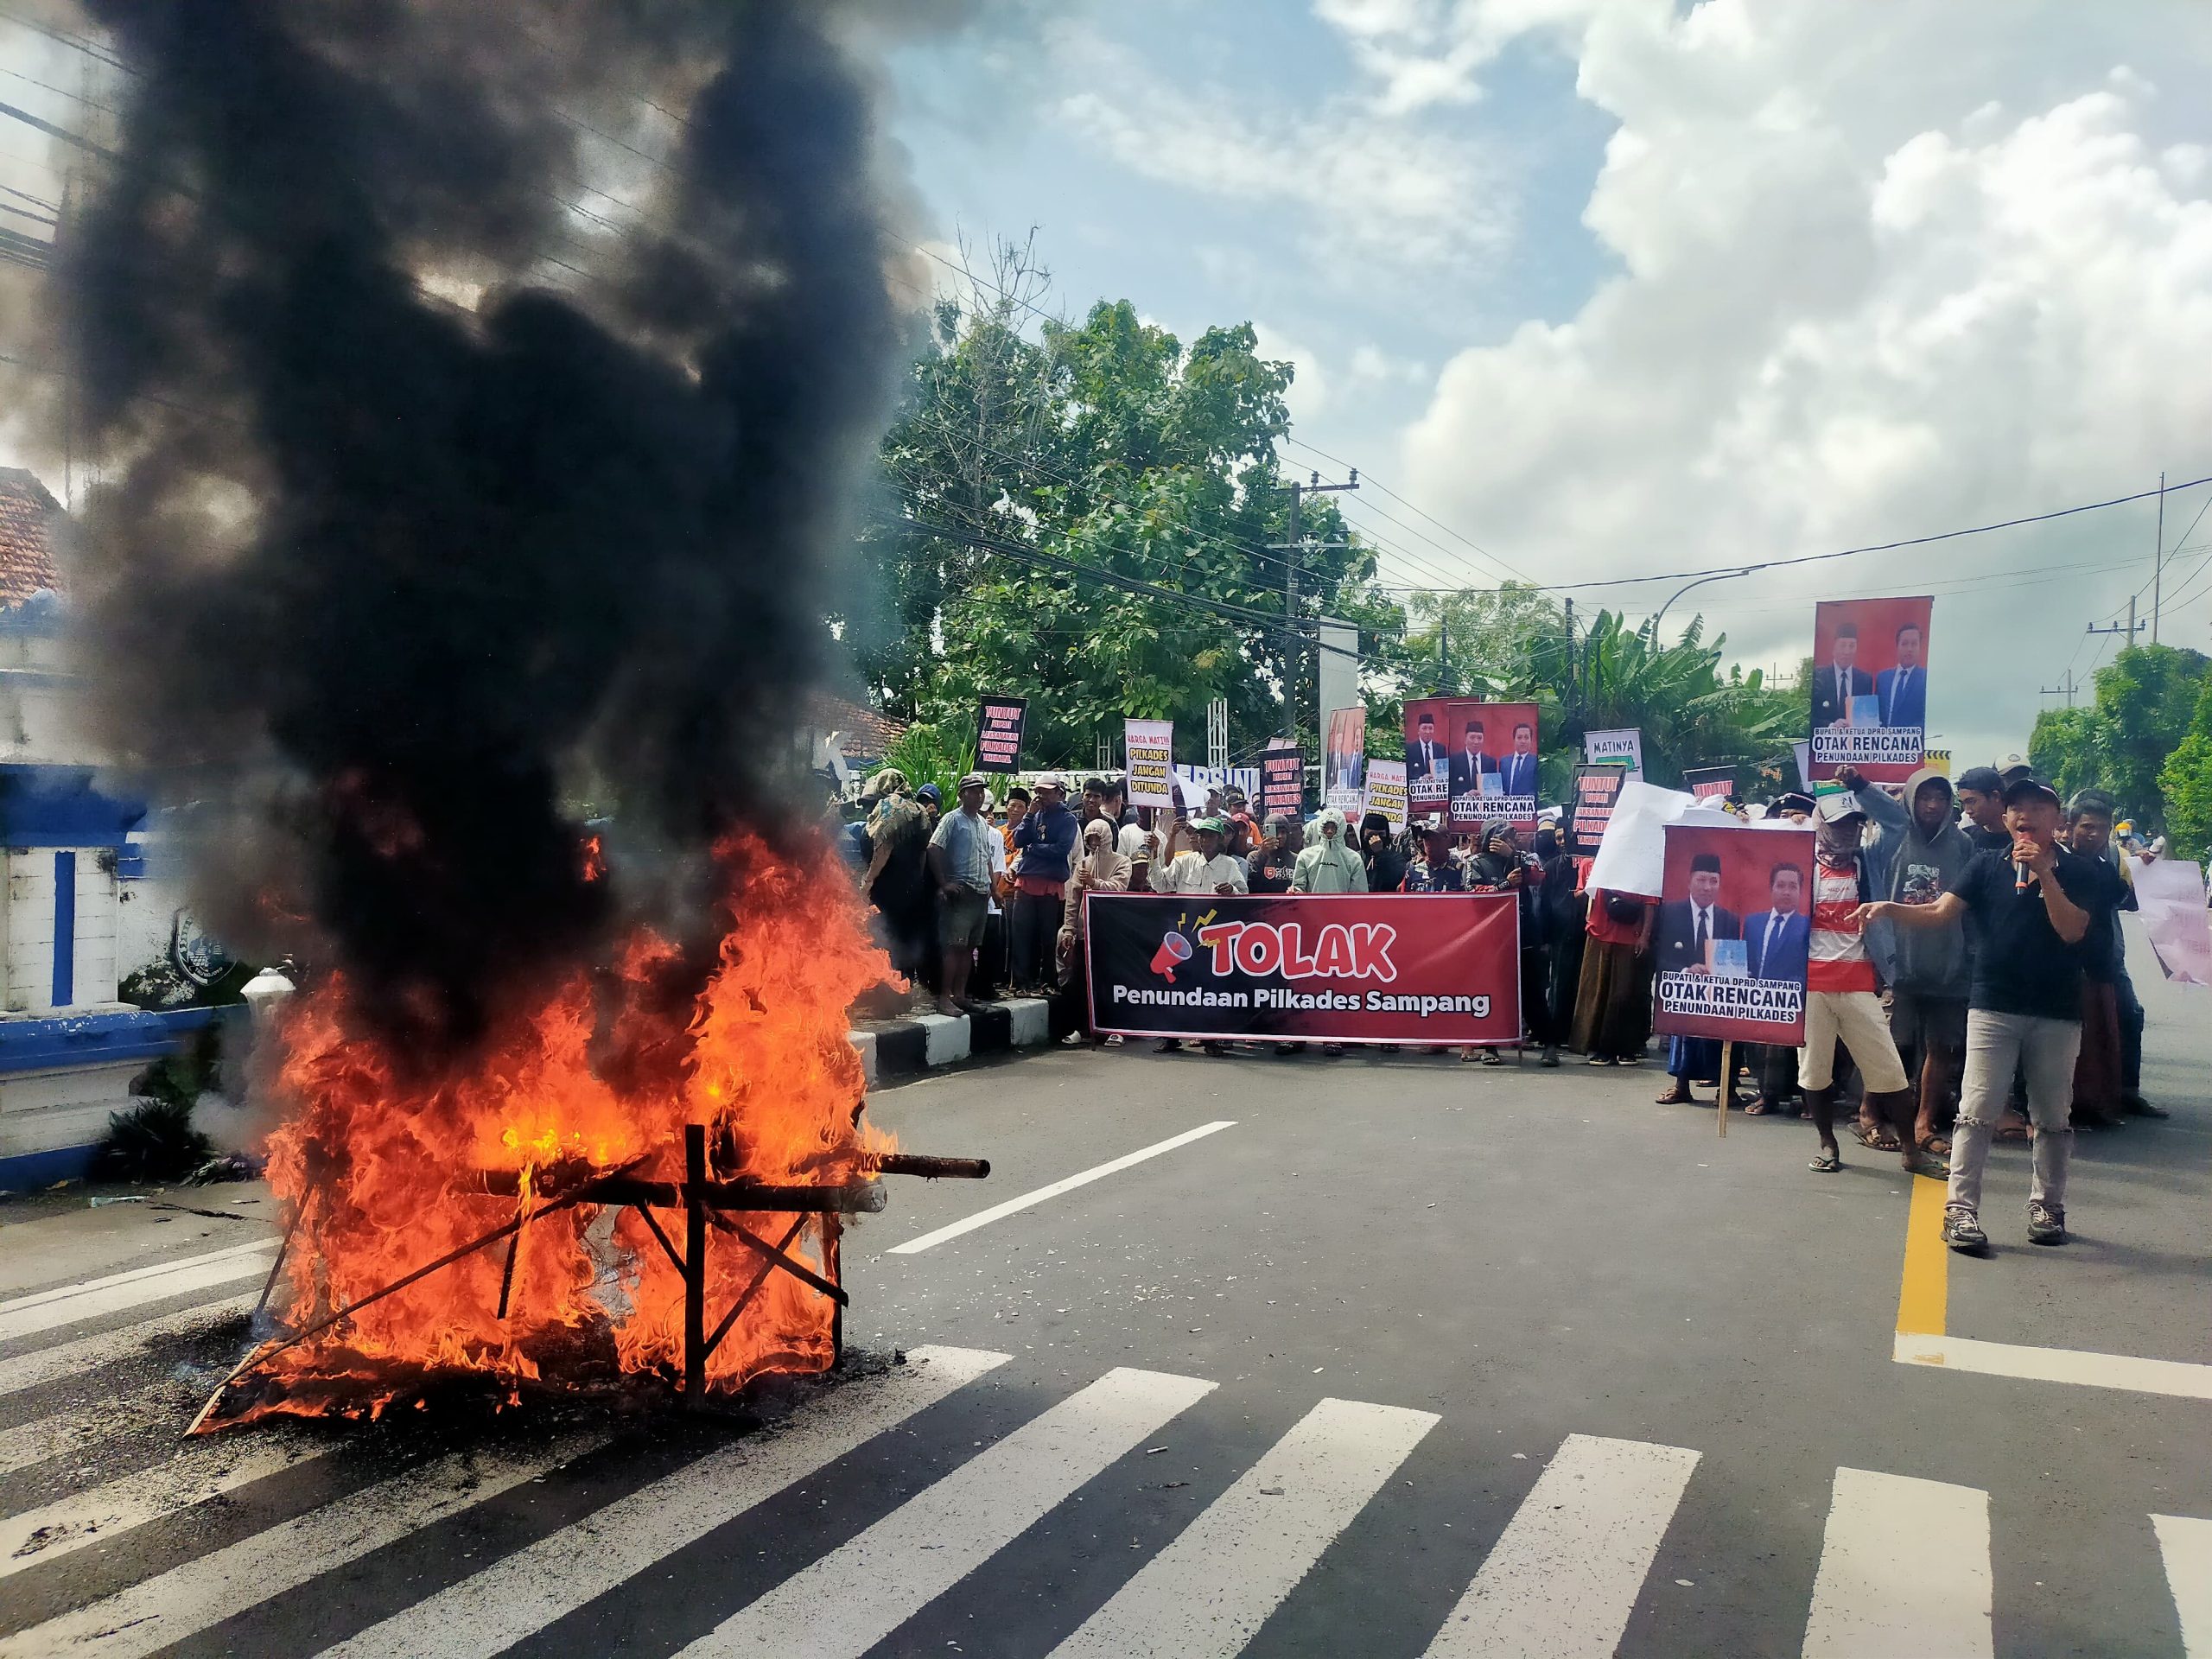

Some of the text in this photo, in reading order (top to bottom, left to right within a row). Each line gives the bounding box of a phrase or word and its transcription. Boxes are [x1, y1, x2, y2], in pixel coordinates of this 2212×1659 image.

[985, 706, 1021, 720] TUNTUT
[1127, 735, 1147, 743] HARGA
[1814, 737, 1920, 751] OTAK RENCANA
[980, 741, 1017, 753] PILKADES
[1594, 740, 1634, 753] MATINYA
[1129, 748, 1168, 761] PILKADES
[1817, 753, 1916, 762] PENUNDAAN PILKADES
[1132, 764, 1166, 778] JANGAN
[1264, 758, 1300, 772] TUNTUT
[1131, 781, 1168, 794] DITUNDA
[1370, 782, 1407, 796] PILKADES
[1410, 785, 1433, 794] OTAK
[1578, 777, 1619, 791] TUNTUT
[1265, 793, 1301, 806] PILKADES
[1369, 796, 1404, 810] JANGAN
[1585, 793, 1608, 803] BUPATI
[1452, 802, 1534, 812] OTAK RENCANA
[1577, 835, 1599, 845] TAHUN
[1198, 921, 1397, 982] TOLAK
[1663, 972, 1692, 982] BUPATI
[1703, 975, 1729, 984] KETUA
[1733, 978, 1756, 987] DPRD
[1758, 979, 1800, 991] SAMPANG
[1113, 985, 1489, 1017] Penundaan Pilkades Sampang
[1662, 982, 1799, 1009] OTAK RENCANA
[1665, 1001, 1794, 1022] PENUNDAAN PILKADES
